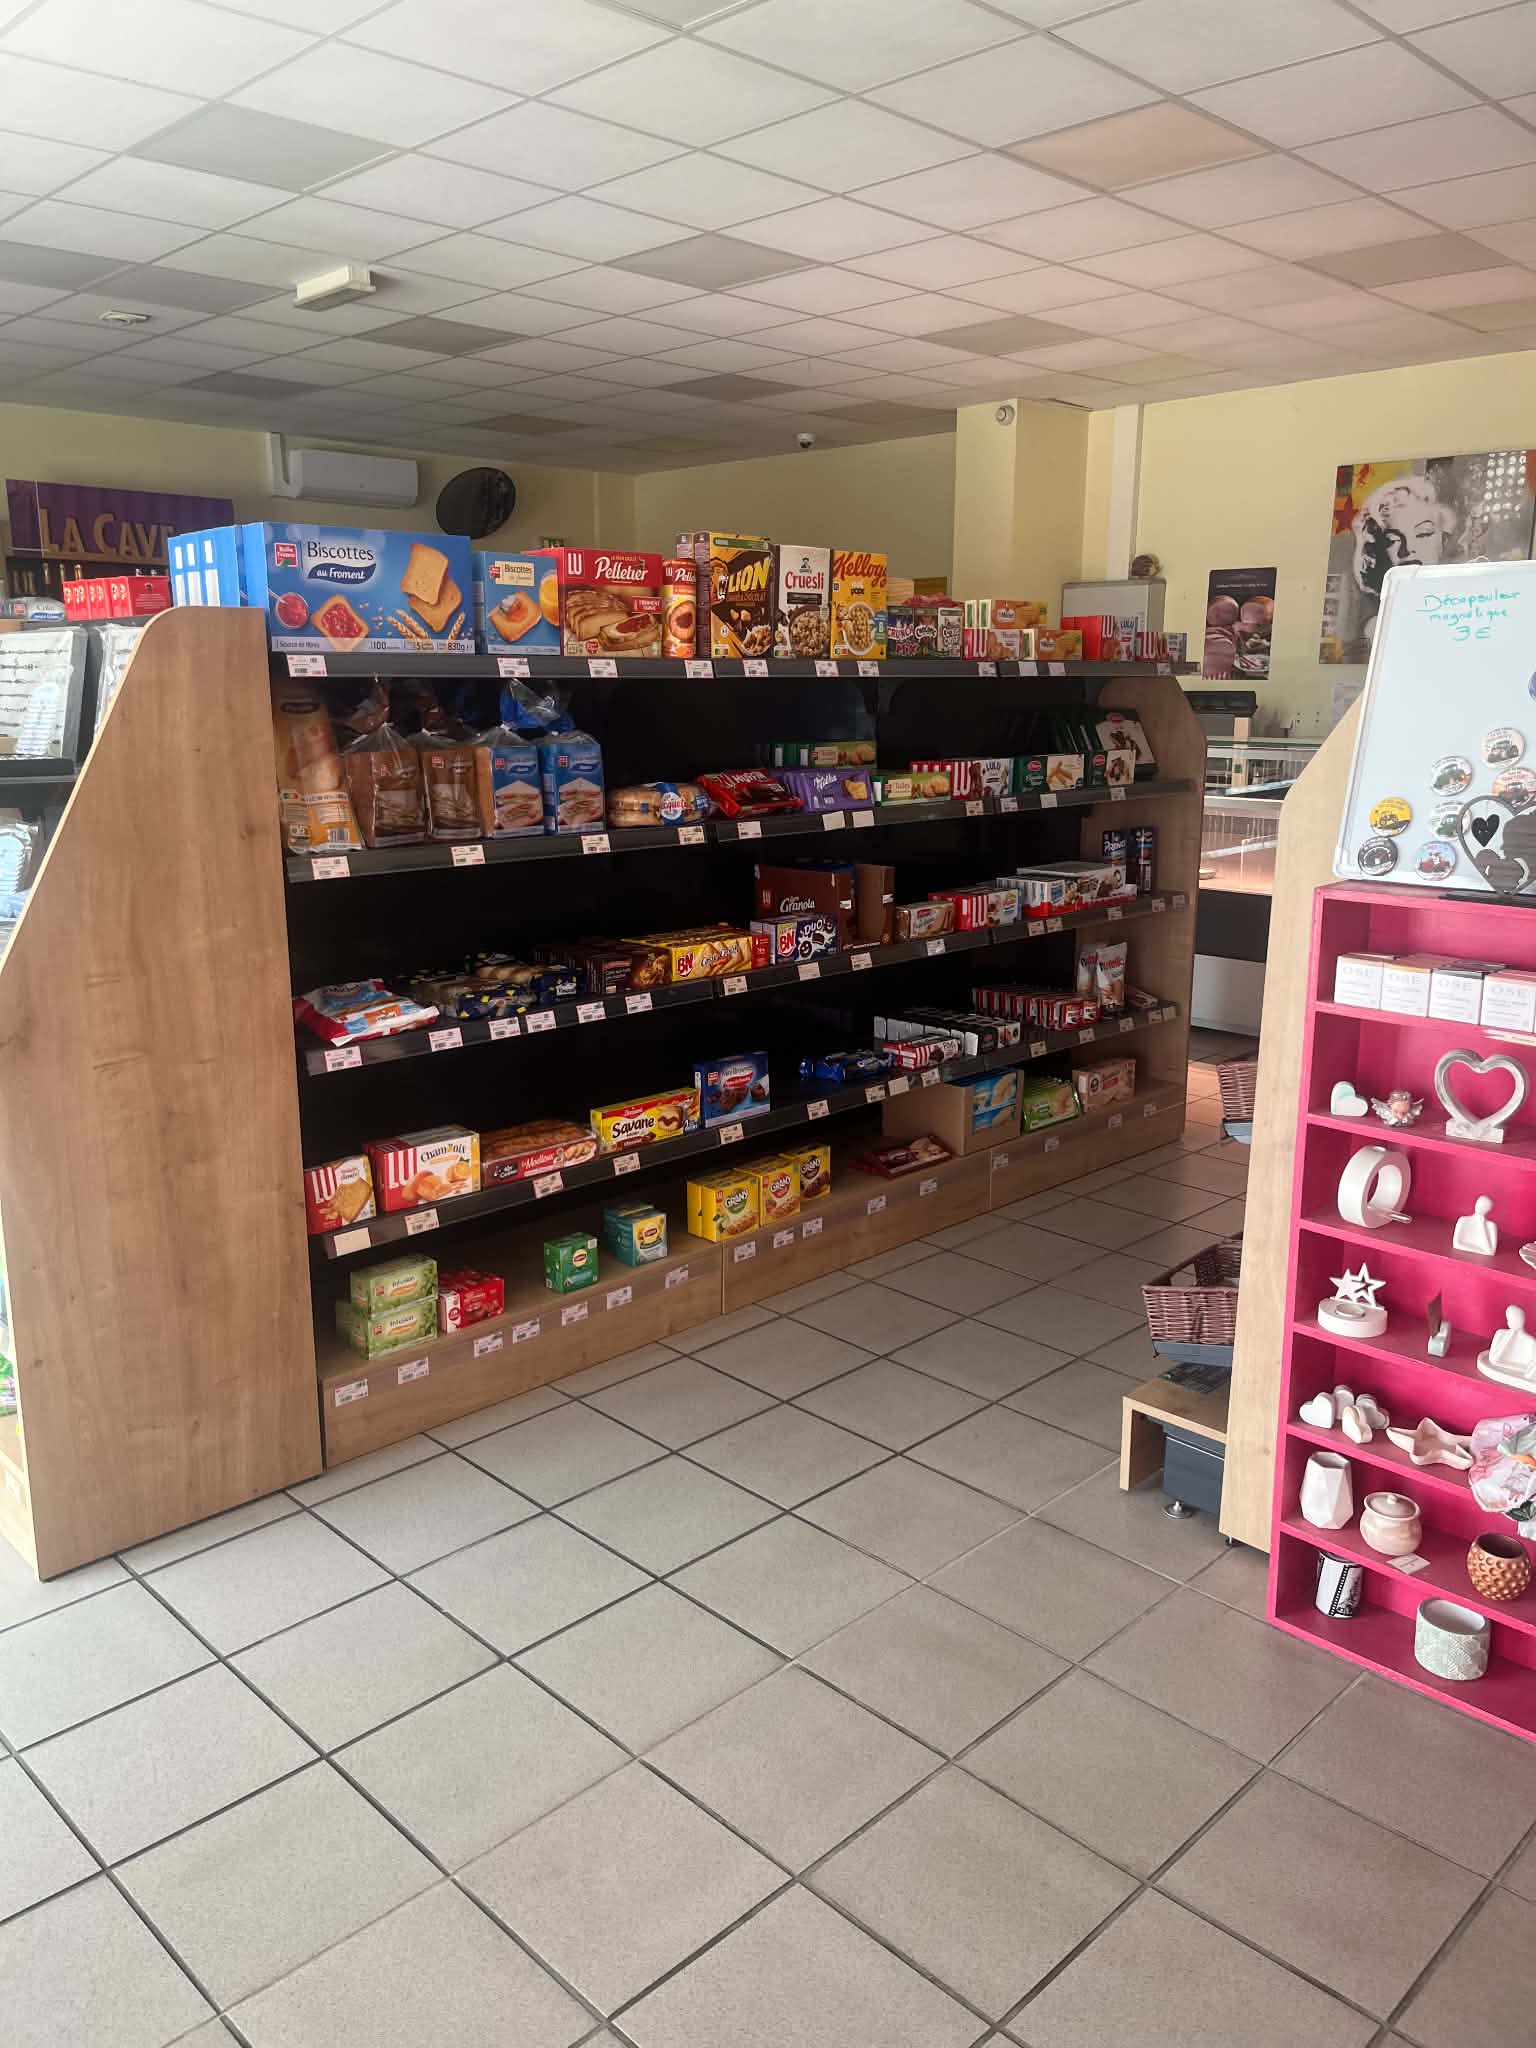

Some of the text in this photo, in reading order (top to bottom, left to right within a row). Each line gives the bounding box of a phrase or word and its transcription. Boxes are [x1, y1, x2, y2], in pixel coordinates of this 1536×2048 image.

[39, 508, 86, 553] LA
[307, 540, 374, 561] Biscottes
[316, 569, 328, 577] au
[567, 552, 583, 576] LU
[594, 556, 649, 581] Pelletier
[727, 555, 771, 593] LION
[784, 571, 825, 591] Cruesli
[1102, 615, 1114, 638] LU
[813, 772, 838, 791] Milka
[953, 761, 971, 797] LU
[780, 896, 816, 914] Granola
[972, 895, 987, 928] LU
[779, 927, 796, 949] BN
[677, 951, 695, 974] BN
[612, 1116, 655, 1139] Savane
[388, 1147, 417, 1190] LU
[312, 1166, 337, 1204] LU
[725, 1190, 748, 1208] GRANY
[392, 1275, 416, 1289] Infusion
[390, 1314, 415, 1328] Infusion
